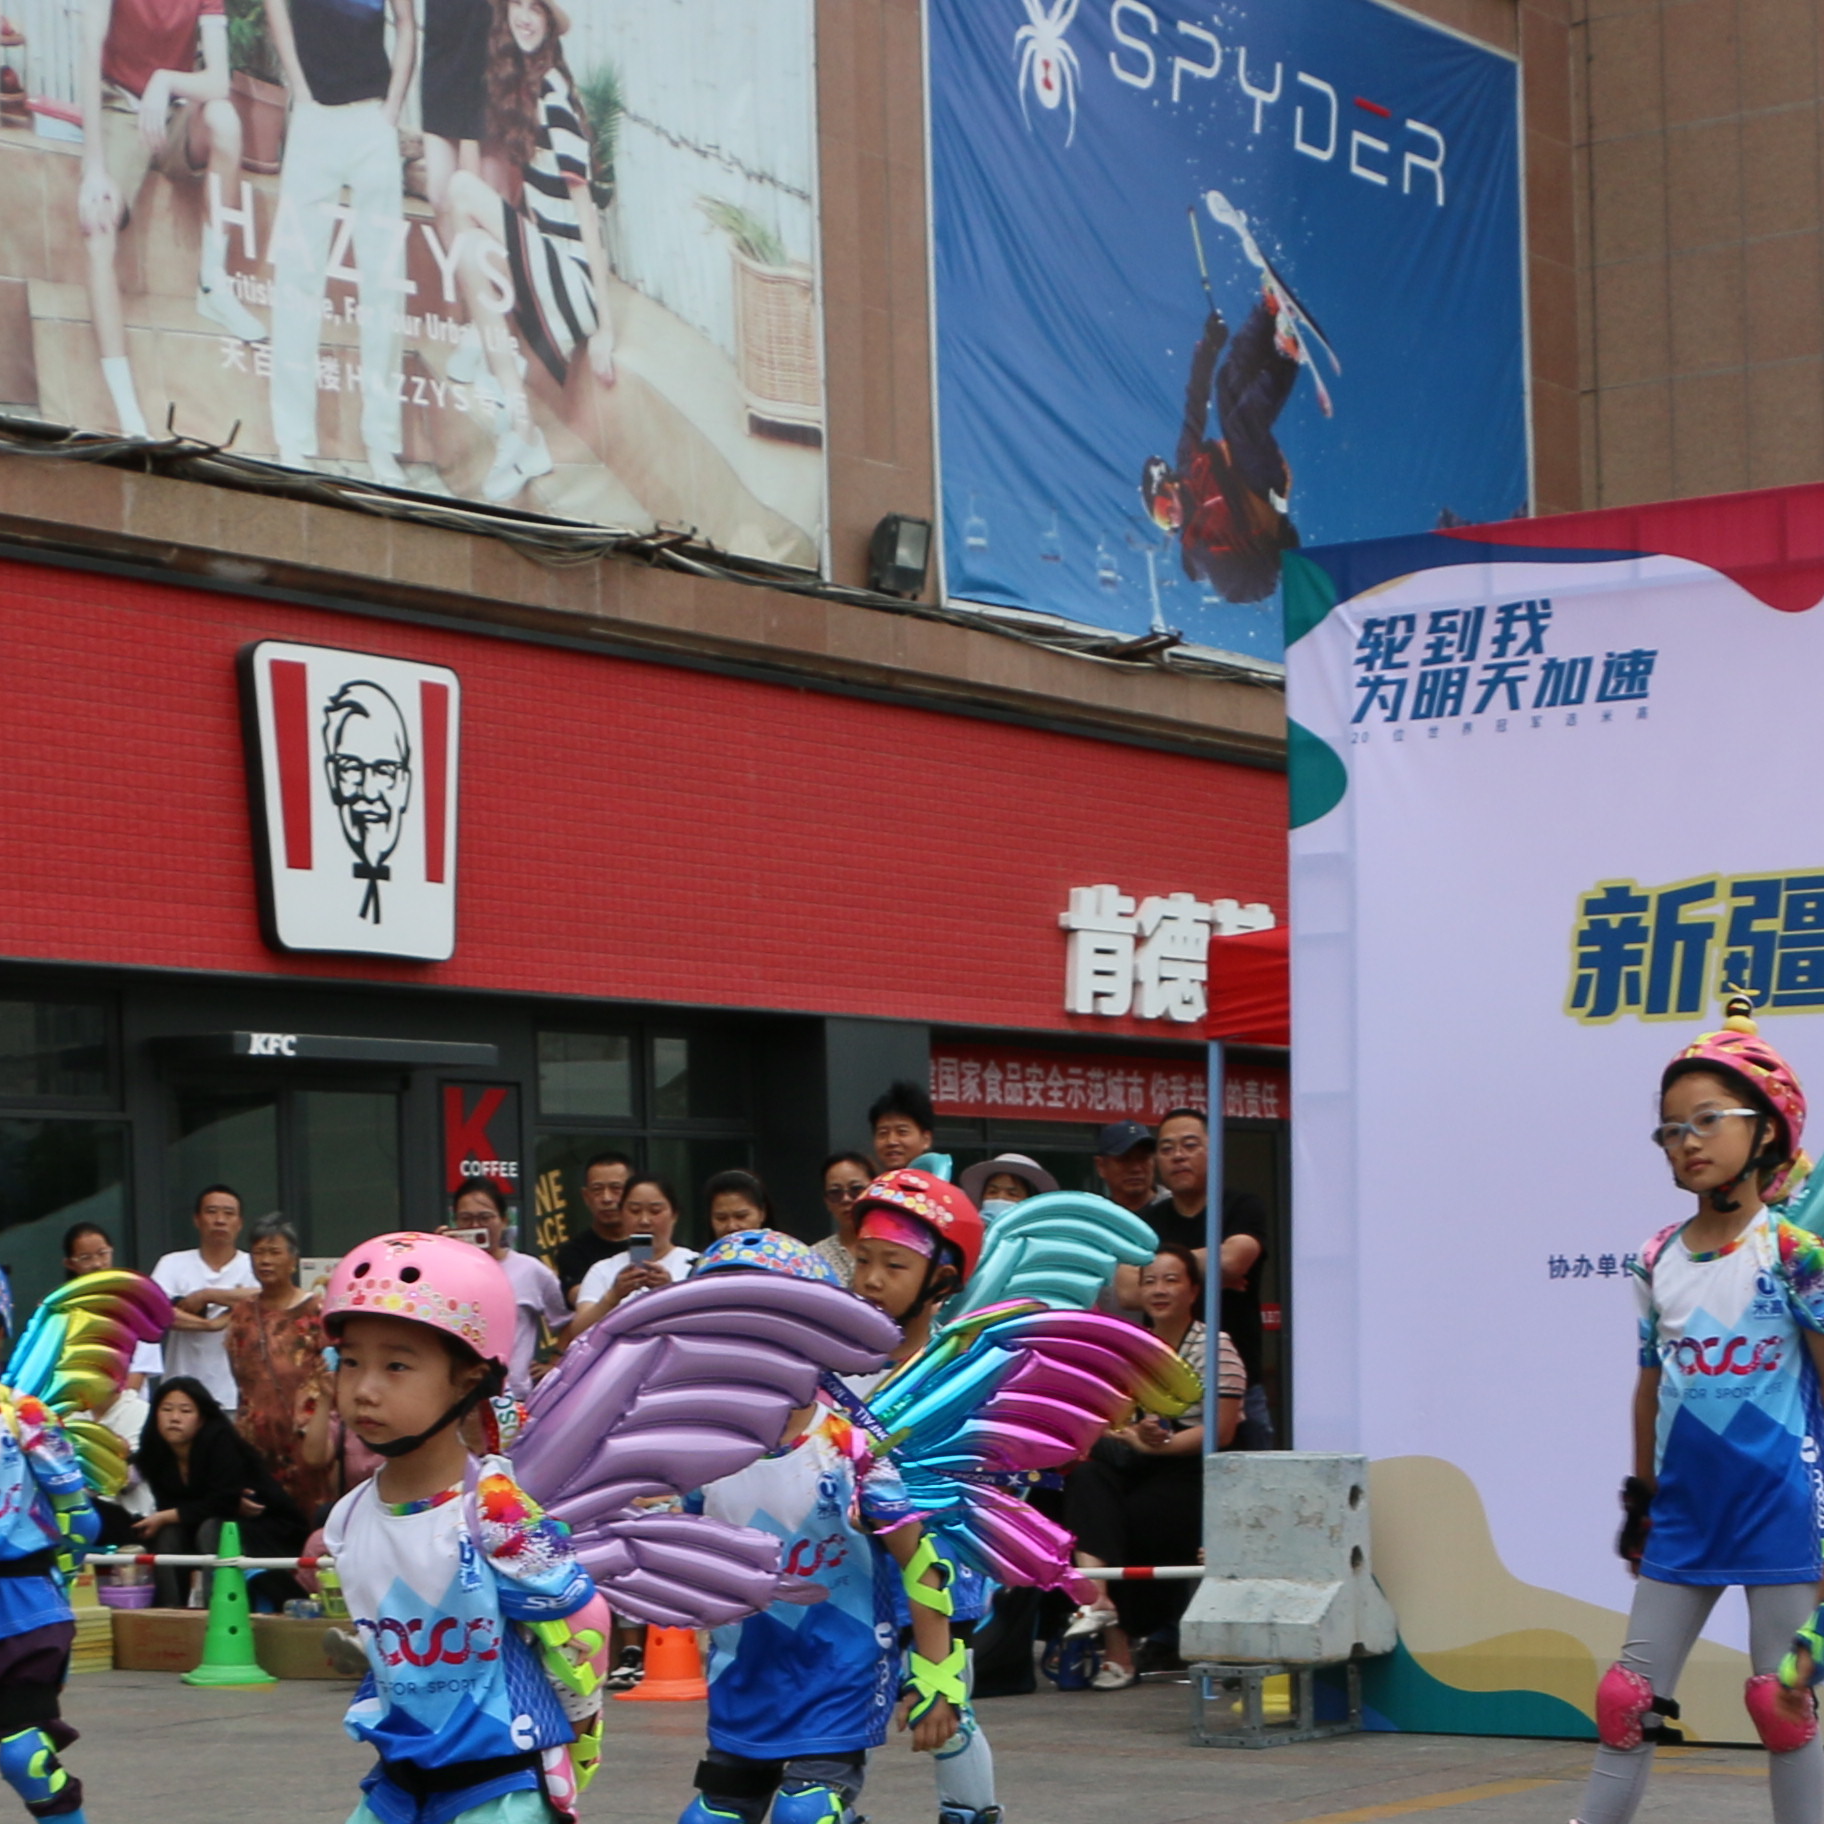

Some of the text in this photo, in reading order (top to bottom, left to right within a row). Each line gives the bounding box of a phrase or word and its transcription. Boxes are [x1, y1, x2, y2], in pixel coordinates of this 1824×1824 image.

[1109, 0, 1445, 207] SPYDER
[208, 172, 516, 314] HAZZYS
[1353, 598, 1553, 672] 轮到我
[1350, 648, 1659, 725] 为明天加速
[248, 1032, 297, 1057] KFC
[1151, 1071, 1280, 1119] 你我共的责任
[443, 1085, 516, 1194] K
[460, 1159, 519, 1178] COFFEE
